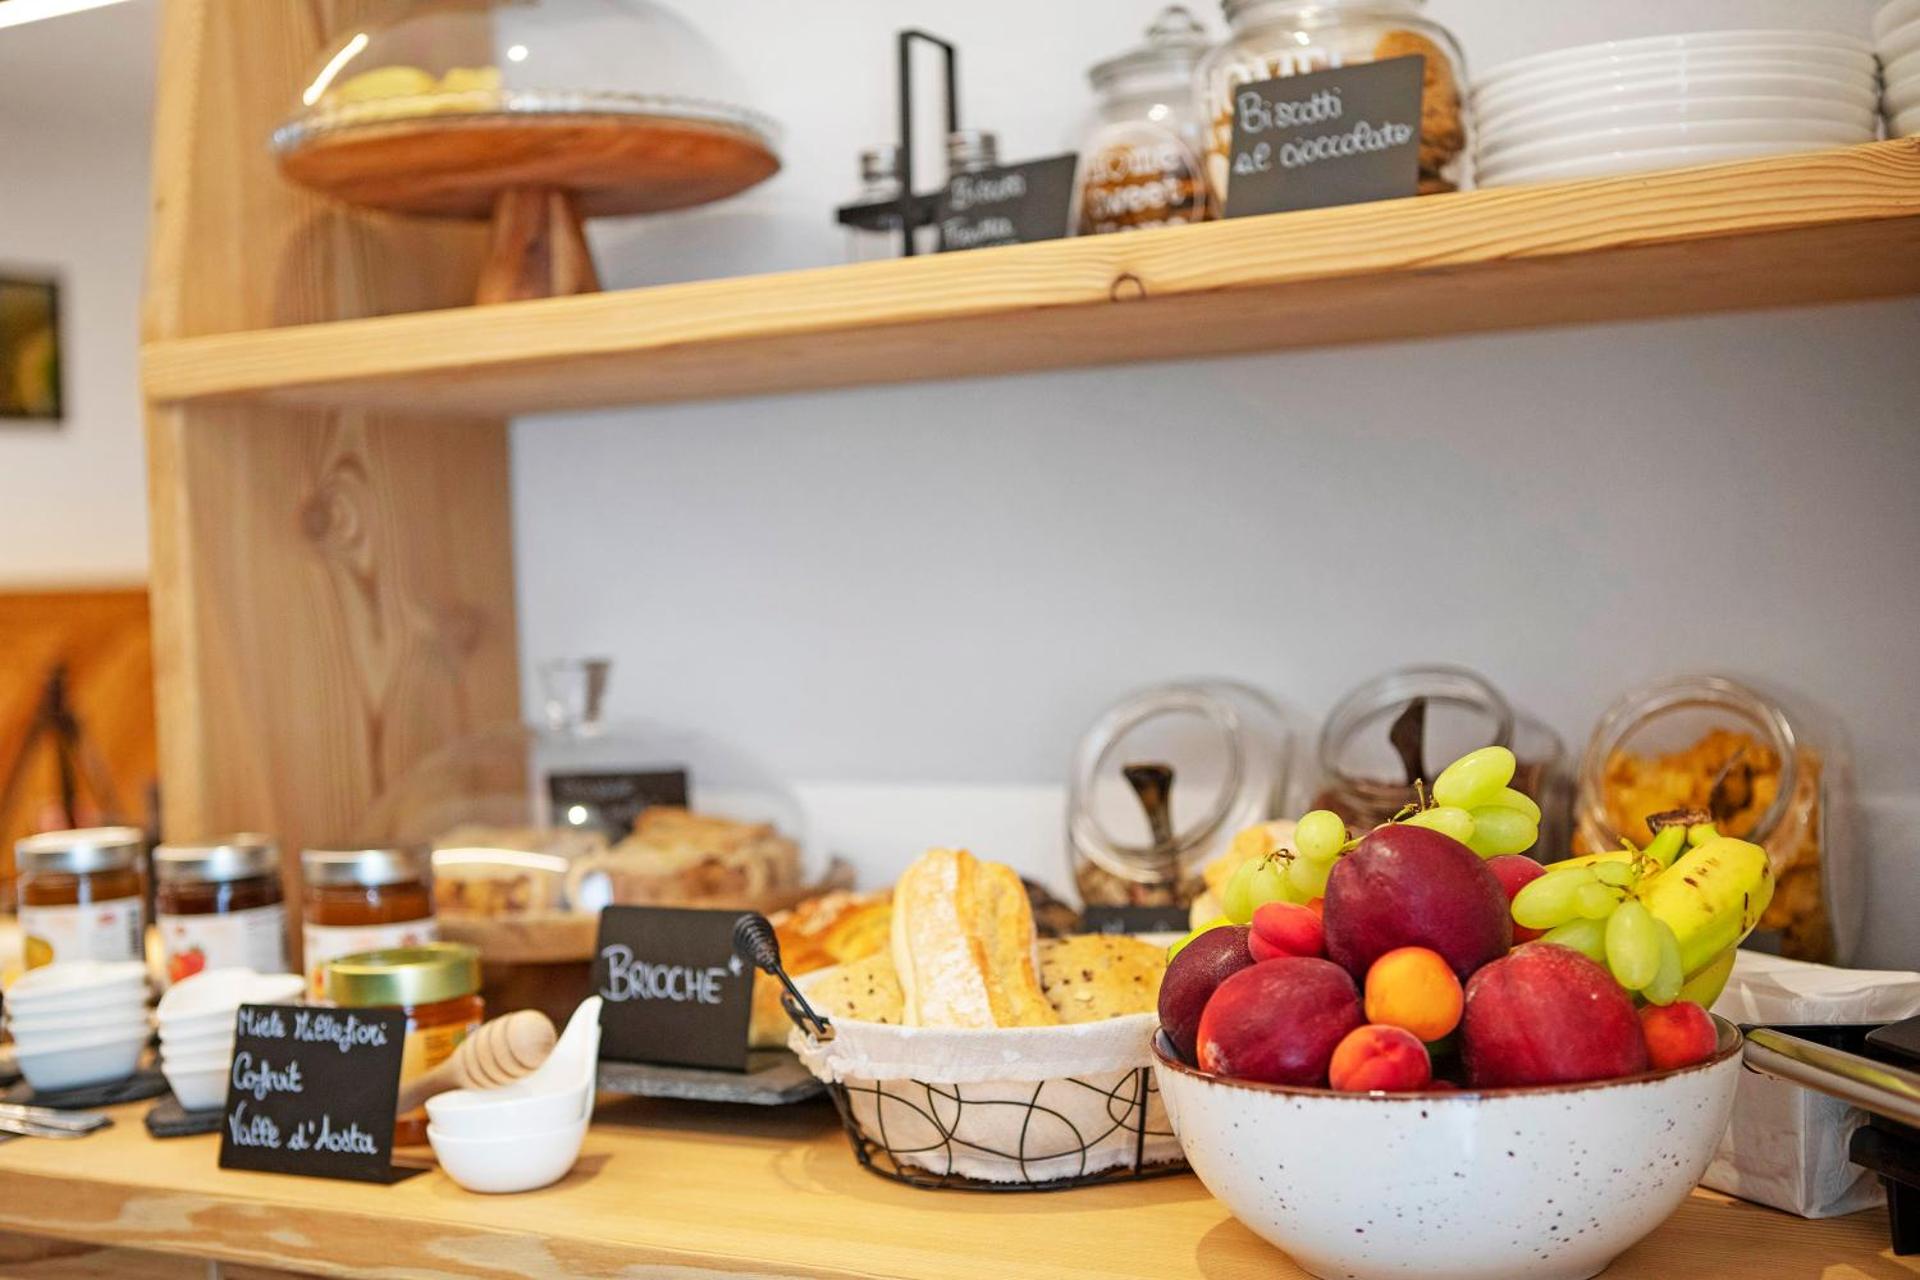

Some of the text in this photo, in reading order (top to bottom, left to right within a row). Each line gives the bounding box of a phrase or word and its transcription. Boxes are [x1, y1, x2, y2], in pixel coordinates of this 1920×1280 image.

[1237, 86, 1343, 134] Biscotti
[1233, 120, 1414, 174] al cioccolato
[599, 943, 728, 1004] BRIOCHE
[238, 1008, 286, 1039] Miele
[228, 1100, 281, 1149] Valle
